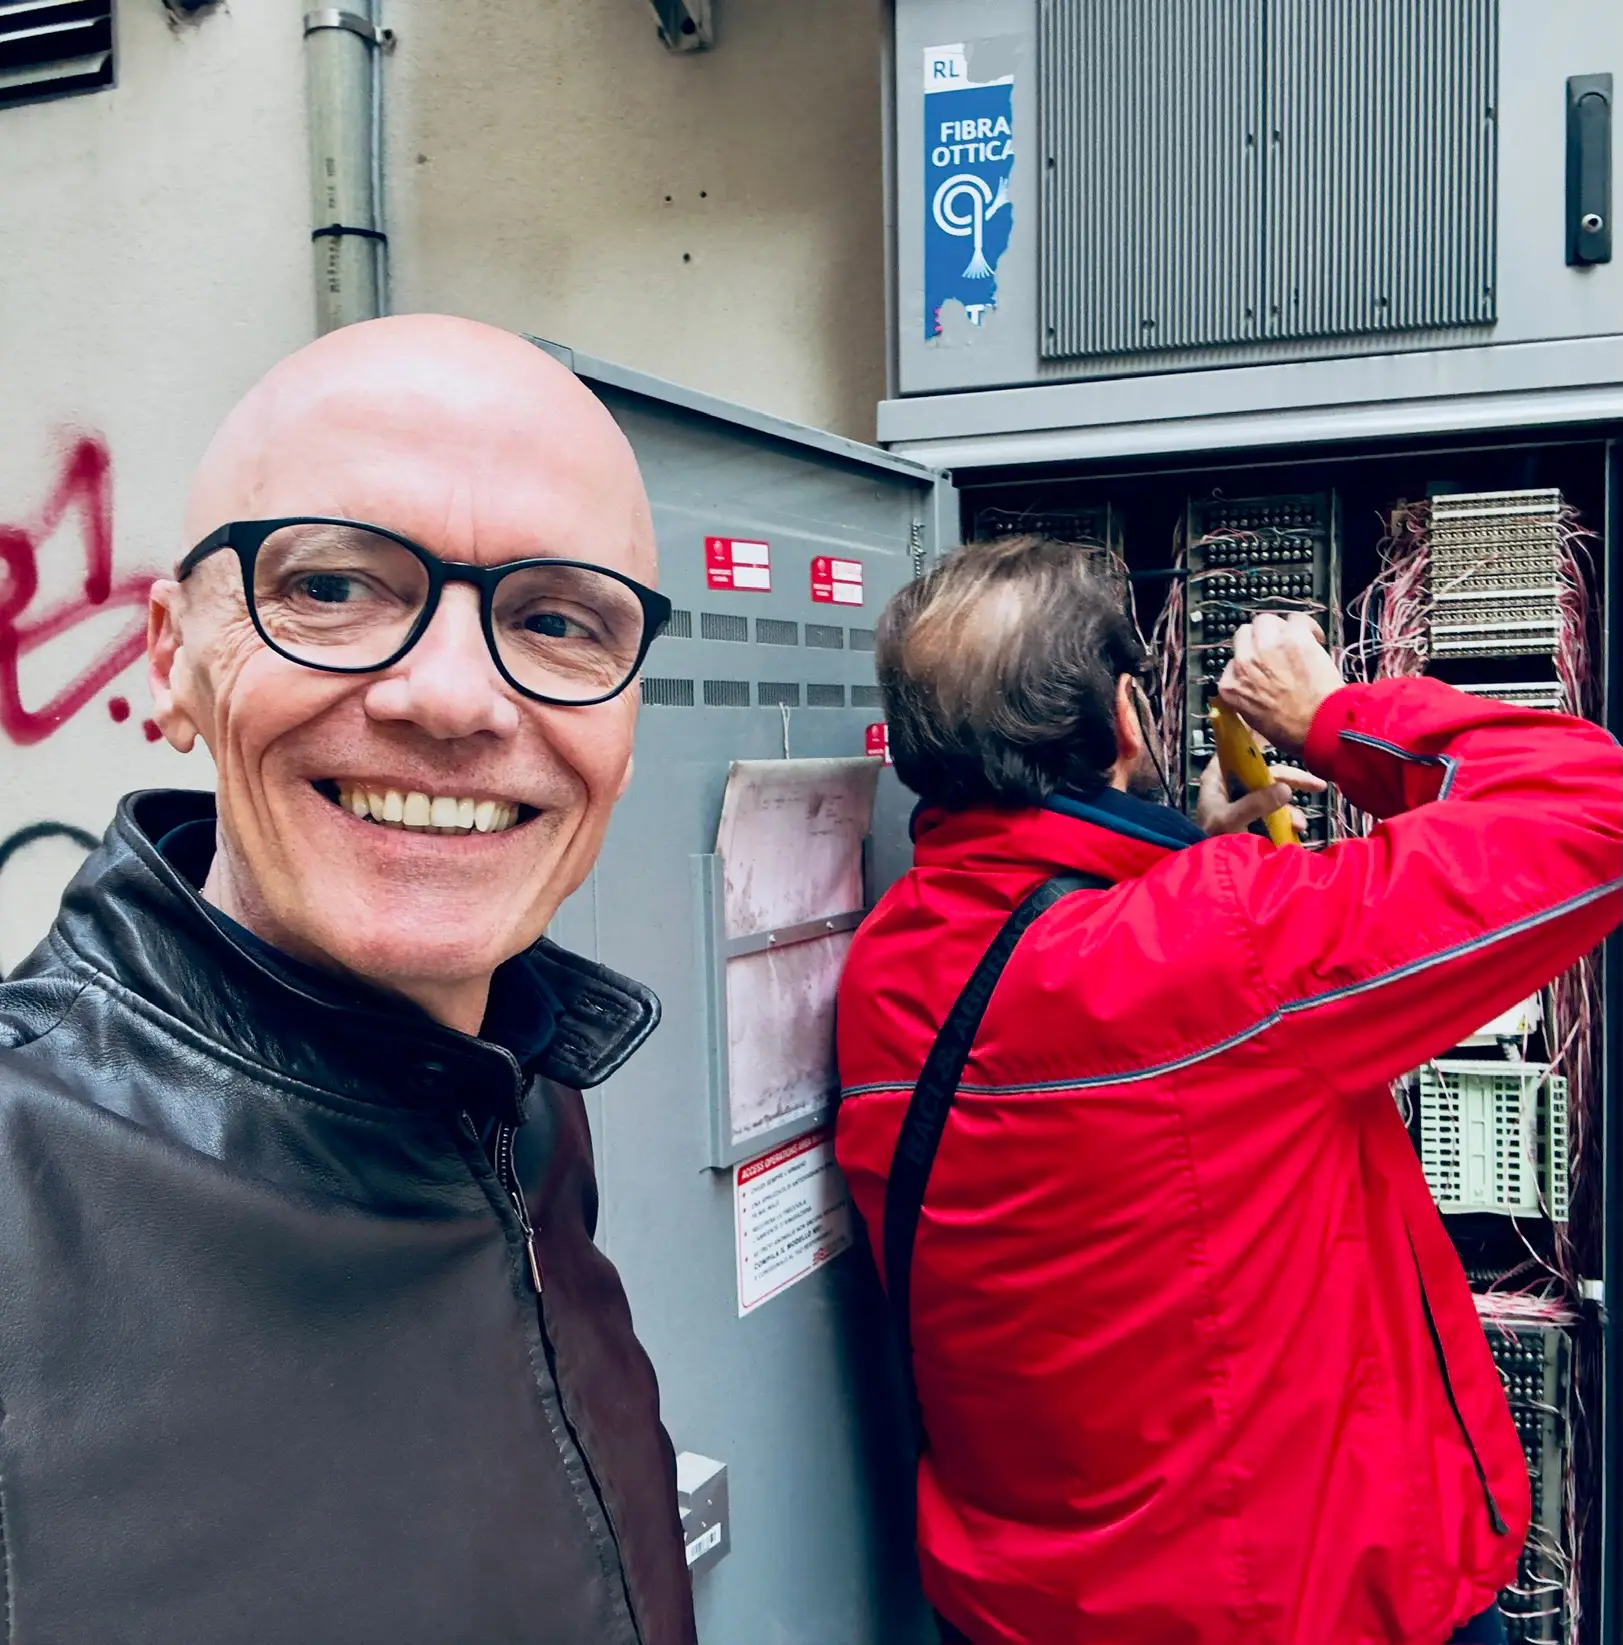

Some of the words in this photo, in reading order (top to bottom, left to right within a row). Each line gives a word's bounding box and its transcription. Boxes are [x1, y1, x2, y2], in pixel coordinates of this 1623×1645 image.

[934, 60, 960, 79] RL
[941, 116, 1012, 143] FIBRA
[932, 139, 1015, 167] OTTICA
[905, 1082, 945, 1166] BACI
[936, 1046, 960, 1082] &
[741, 1161, 764, 1179] ACCESS
